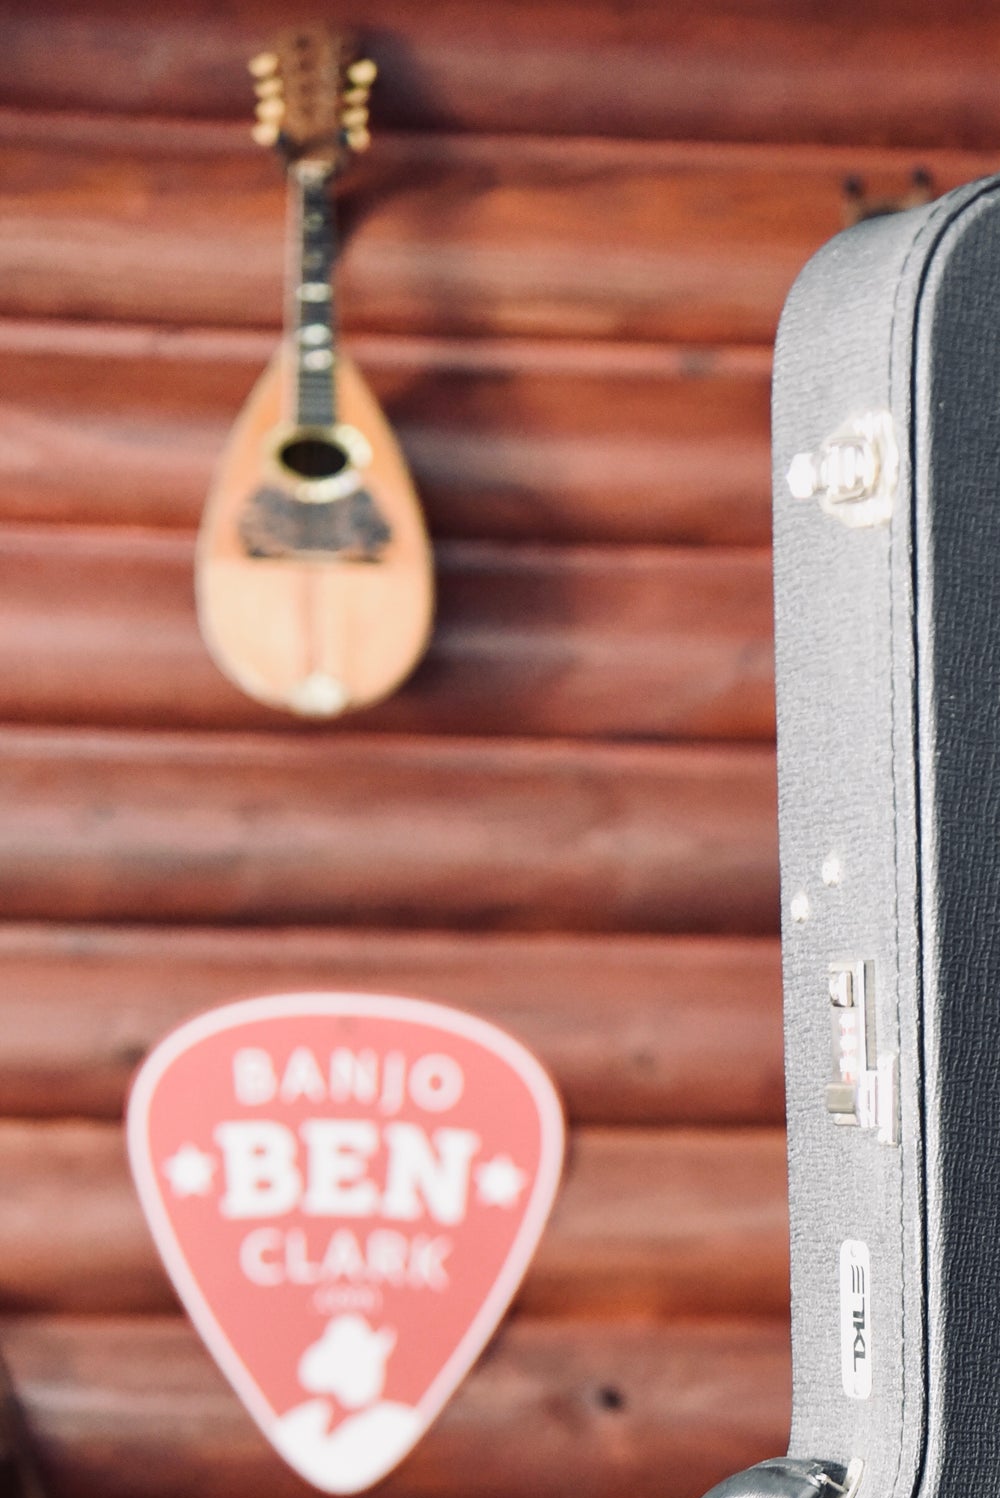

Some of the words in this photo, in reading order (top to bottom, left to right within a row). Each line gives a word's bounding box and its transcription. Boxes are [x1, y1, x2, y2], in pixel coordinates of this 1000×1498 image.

[232, 1046, 465, 1115] BANJO
[213, 1118, 481, 1227] BEN
[239, 1227, 453, 1292] CLARK
